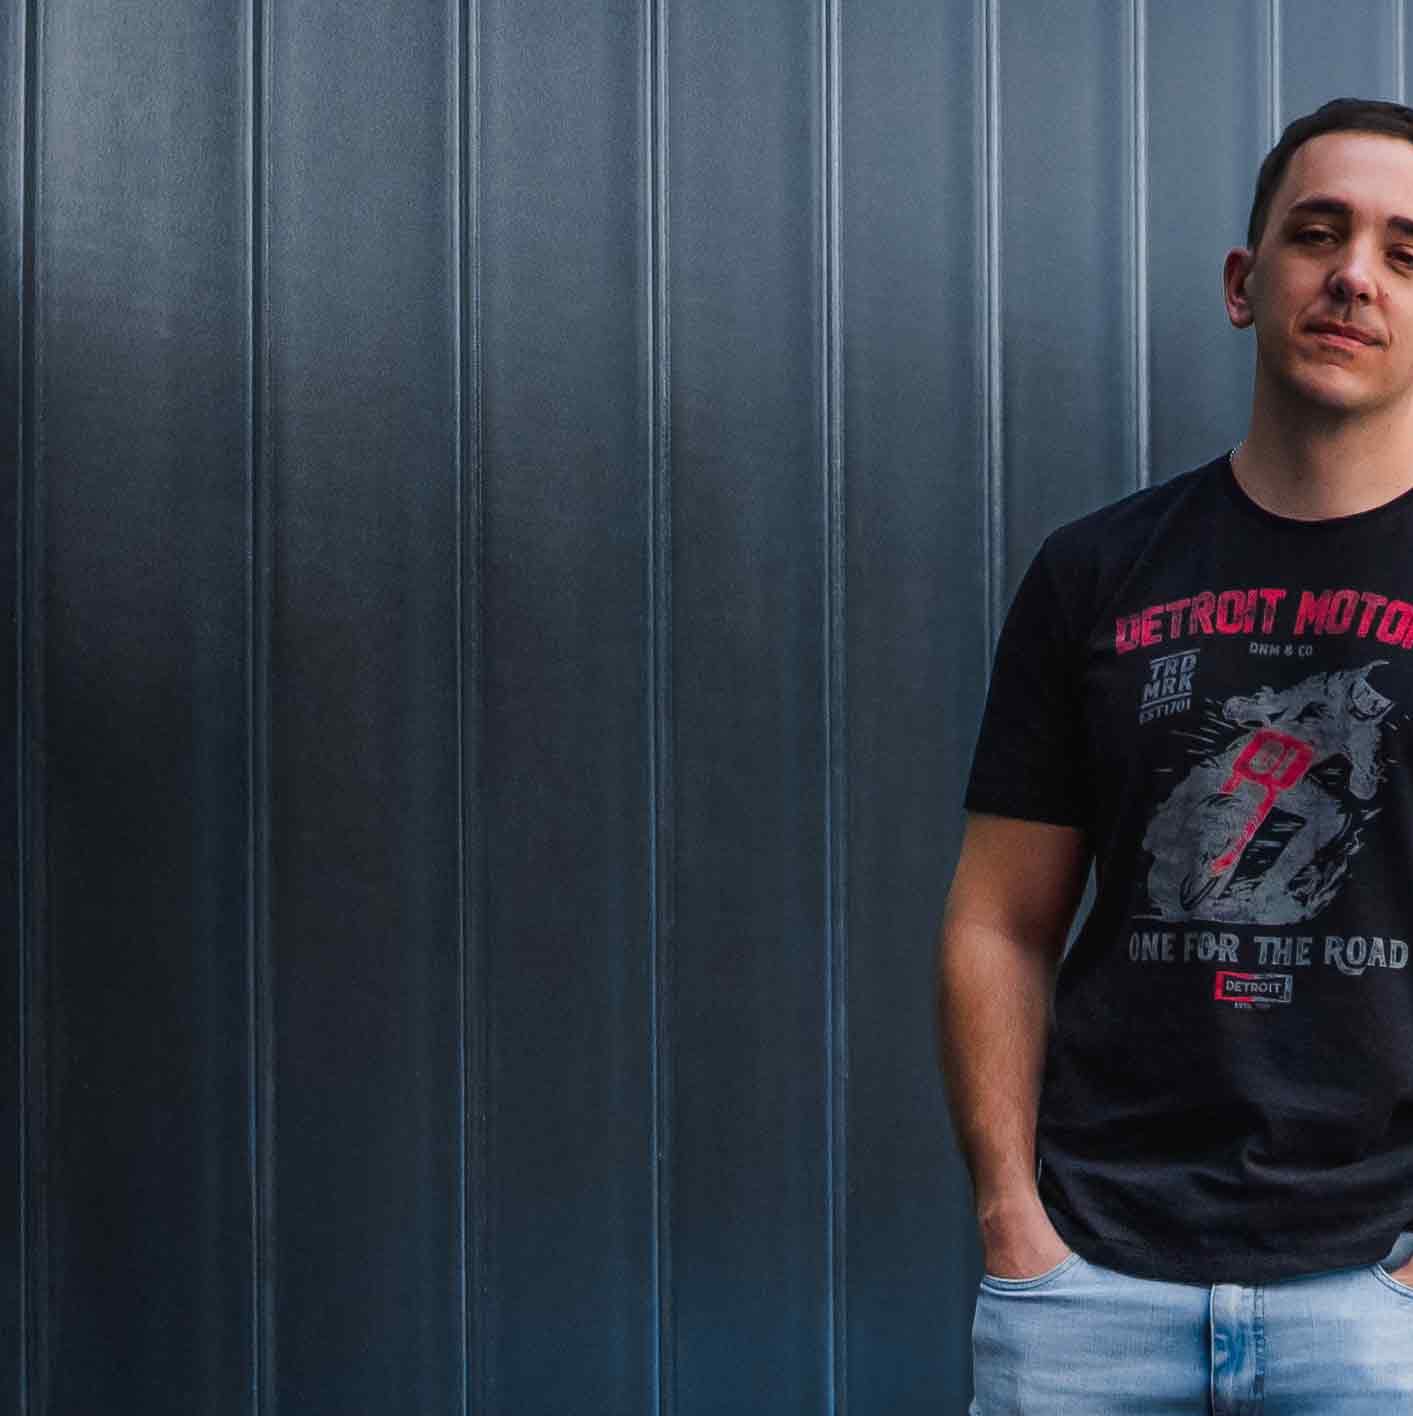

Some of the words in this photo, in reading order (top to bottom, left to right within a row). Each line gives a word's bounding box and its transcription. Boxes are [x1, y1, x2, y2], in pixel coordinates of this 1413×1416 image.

[1115, 588, 1287, 655] DETROIT
[1151, 654, 1197, 680] TRD
[1143, 672, 1192, 701] MRK
[1129, 932, 1175, 962] ONE
[1184, 932, 1239, 963] FOR
[1254, 936, 1312, 966] THE
[1324, 936, 1409, 975] ROAD
[1225, 980, 1281, 993] DETROIT
